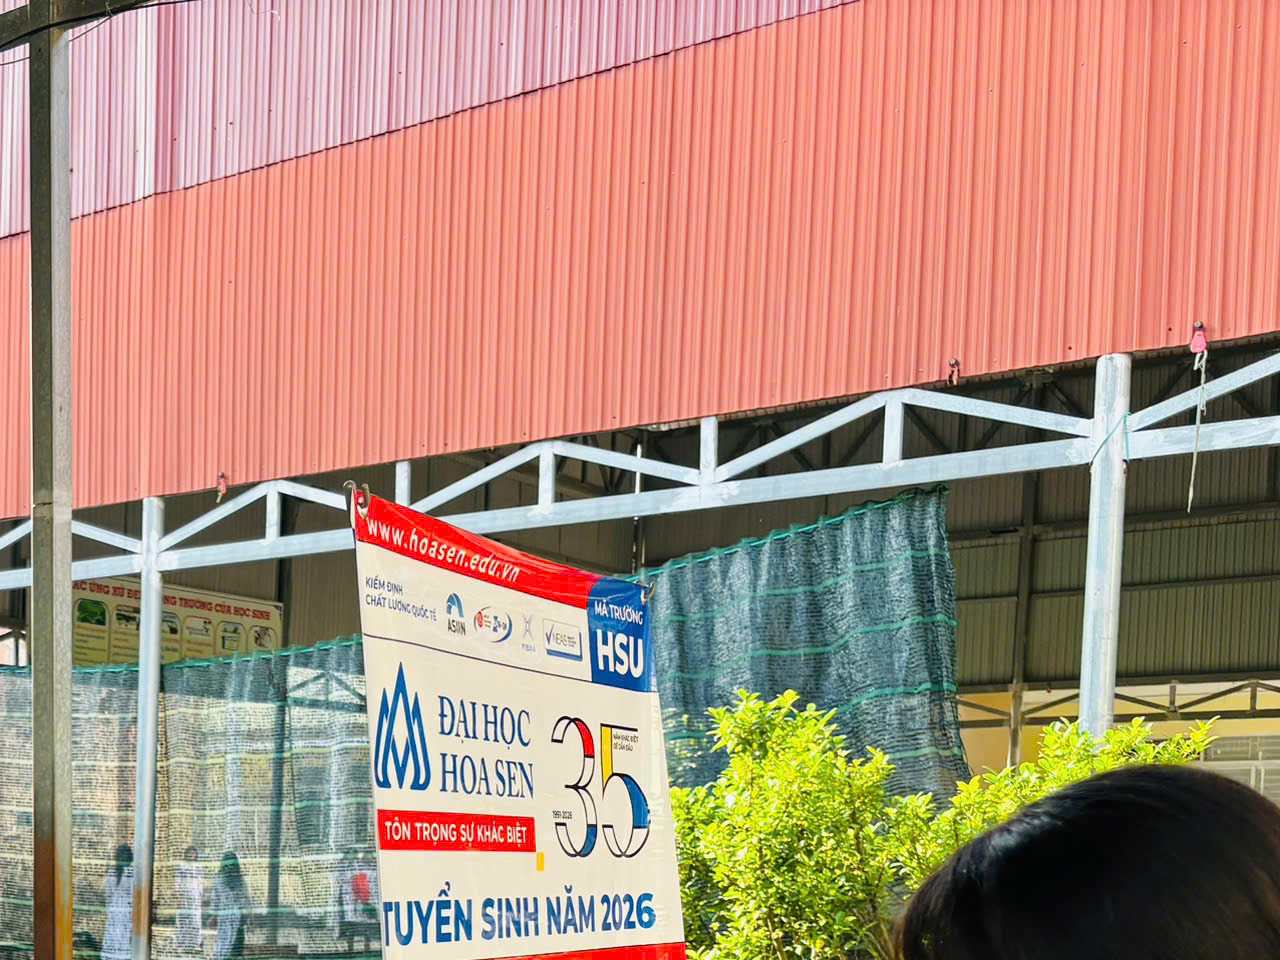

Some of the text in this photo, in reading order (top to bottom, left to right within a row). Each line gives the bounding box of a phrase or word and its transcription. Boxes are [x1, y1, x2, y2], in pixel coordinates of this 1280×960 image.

[366, 516, 520, 583] www.hoasen.edu.vn
[595, 600, 644, 625] MÃ TRƯỜNG
[596, 628, 644, 678] HSU
[438, 695, 531, 750] ĐẠI HỌC
[440, 752, 534, 799] HOA SEN
[551, 715, 651, 858] 35
[385, 816, 528, 847] TÔN TRỌNG SỰ KHÁC BIỆT
[383, 881, 657, 946] TUYỂN SINH NĂM 2026
